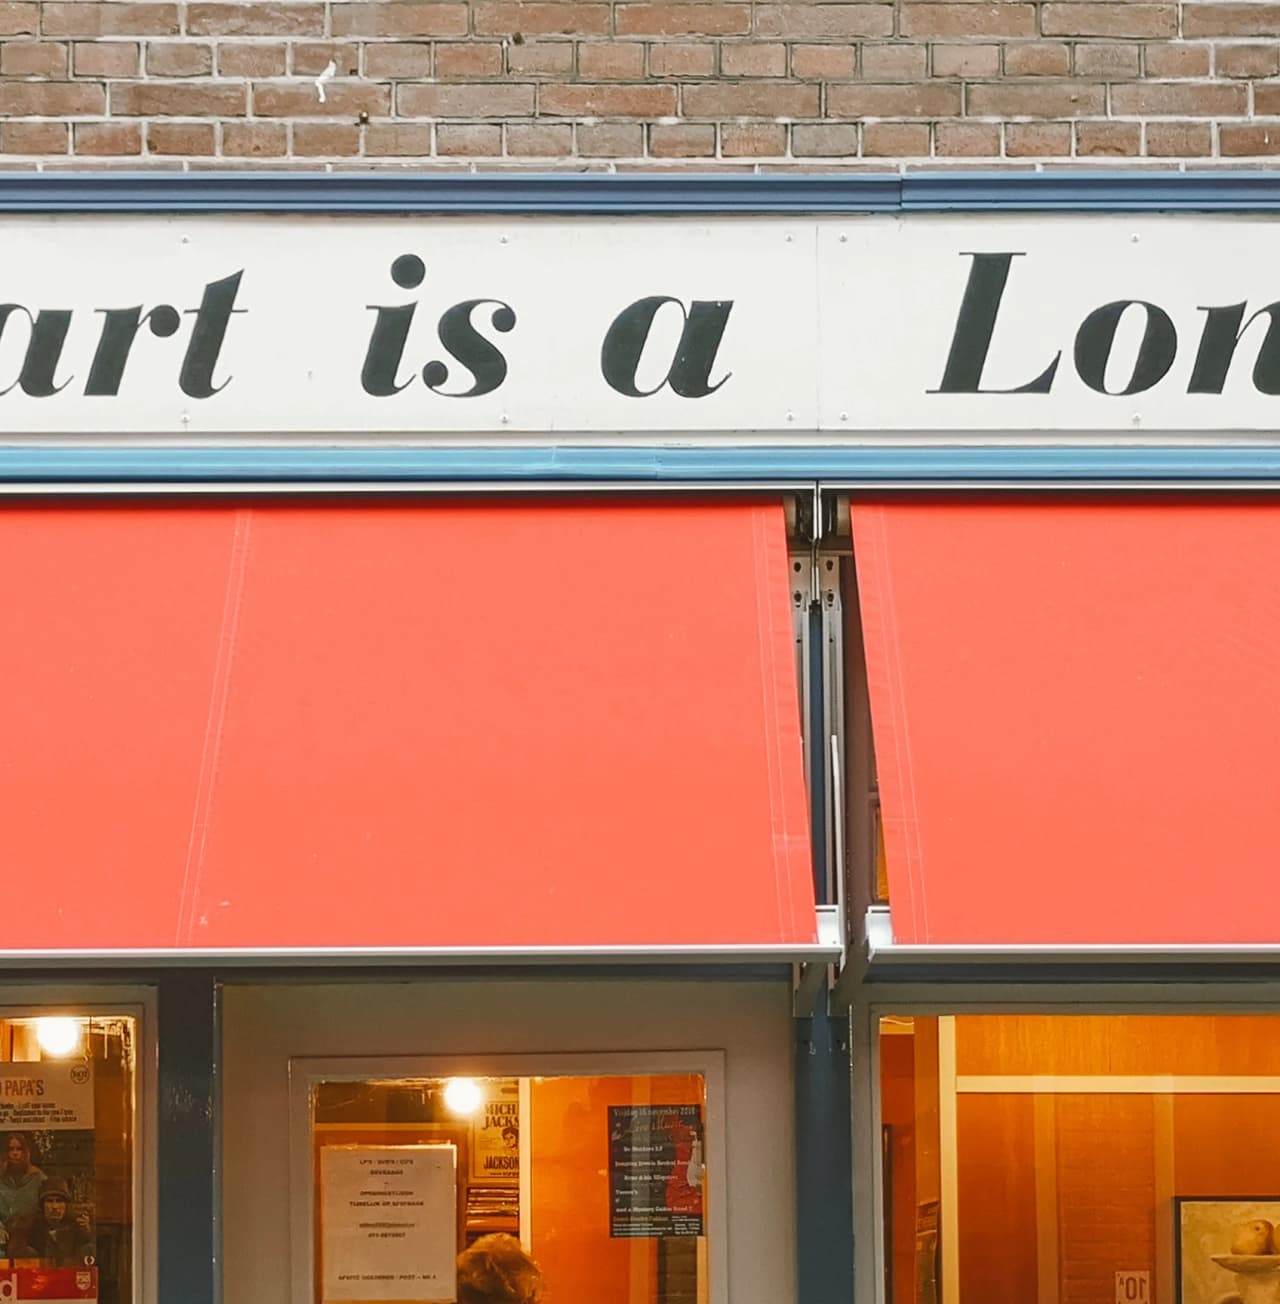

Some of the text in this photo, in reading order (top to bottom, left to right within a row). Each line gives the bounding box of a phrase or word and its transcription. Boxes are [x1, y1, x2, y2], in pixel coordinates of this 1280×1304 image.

[362, 255, 515, 397] is
[602, 297, 732, 397] a
[4, 1080, 44, 1096] PAPA'S
